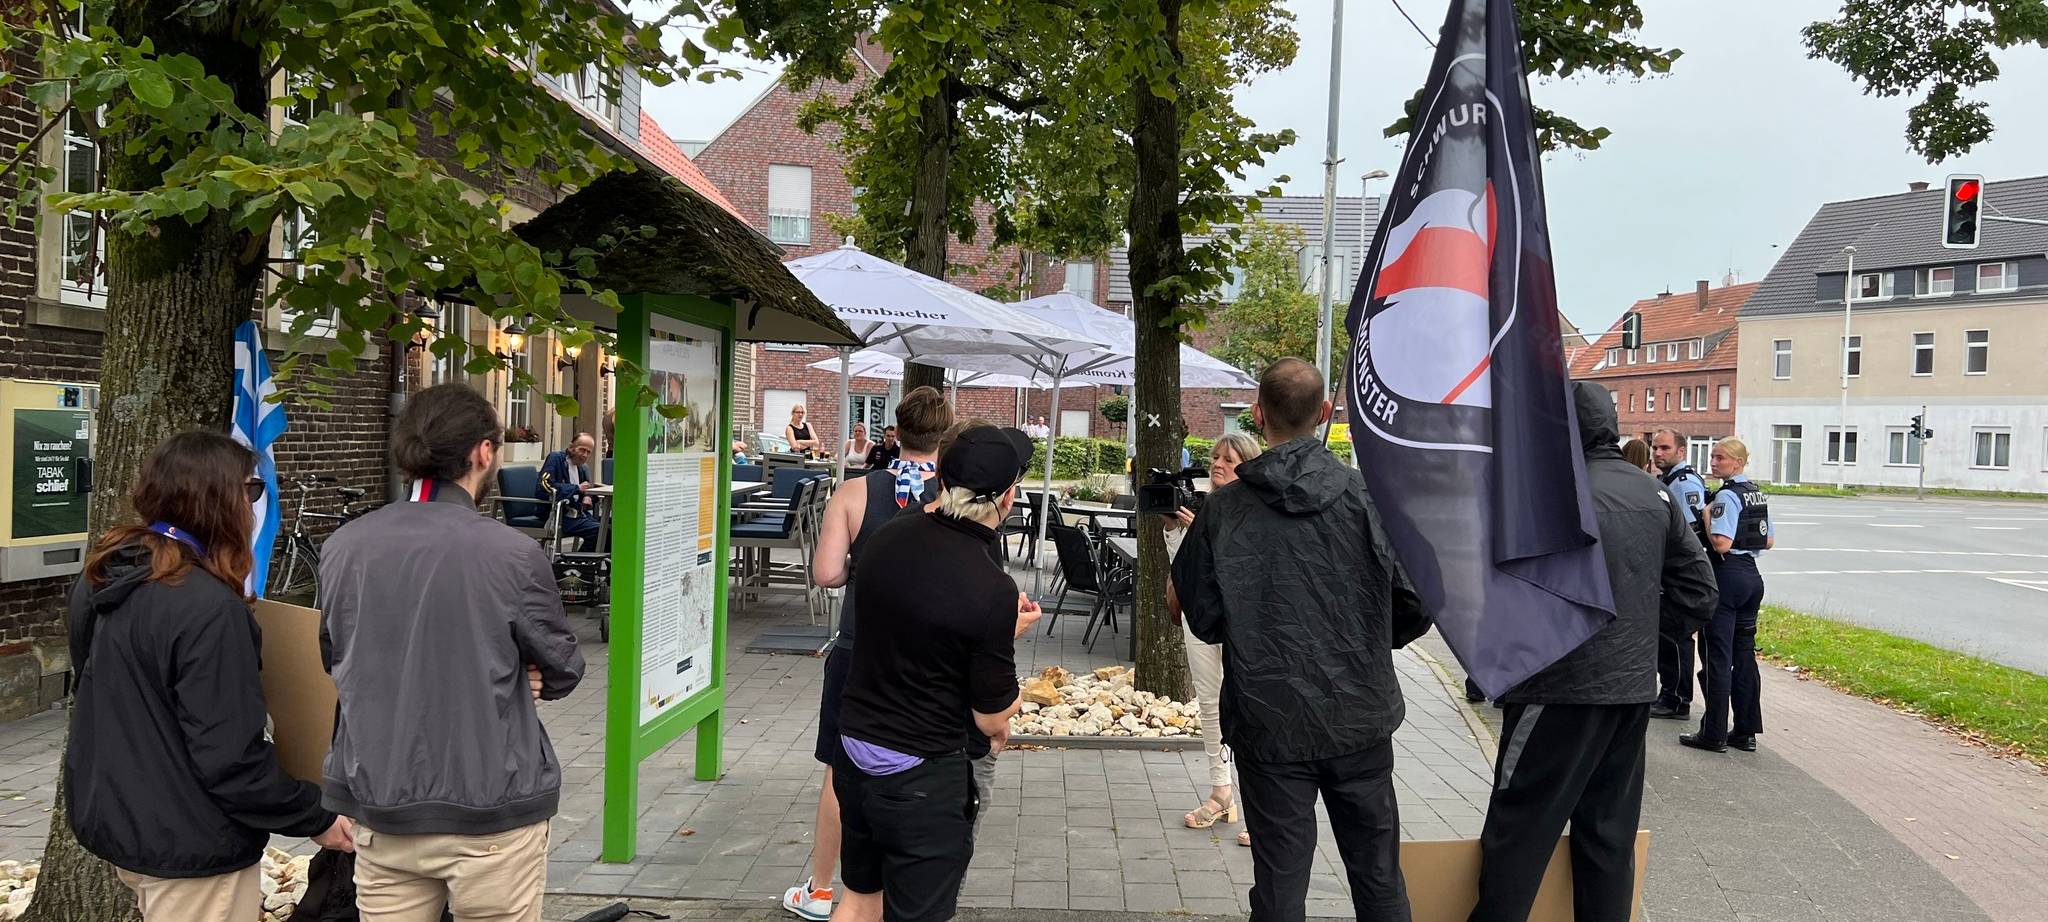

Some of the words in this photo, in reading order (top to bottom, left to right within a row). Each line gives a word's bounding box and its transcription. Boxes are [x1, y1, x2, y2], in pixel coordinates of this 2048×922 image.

[1410, 103, 1487, 200] SCHWUR
[1358, 317, 1399, 425] MÜNSTER
[36, 479, 69, 493] schlief
[37, 467, 64, 478] TABAK
